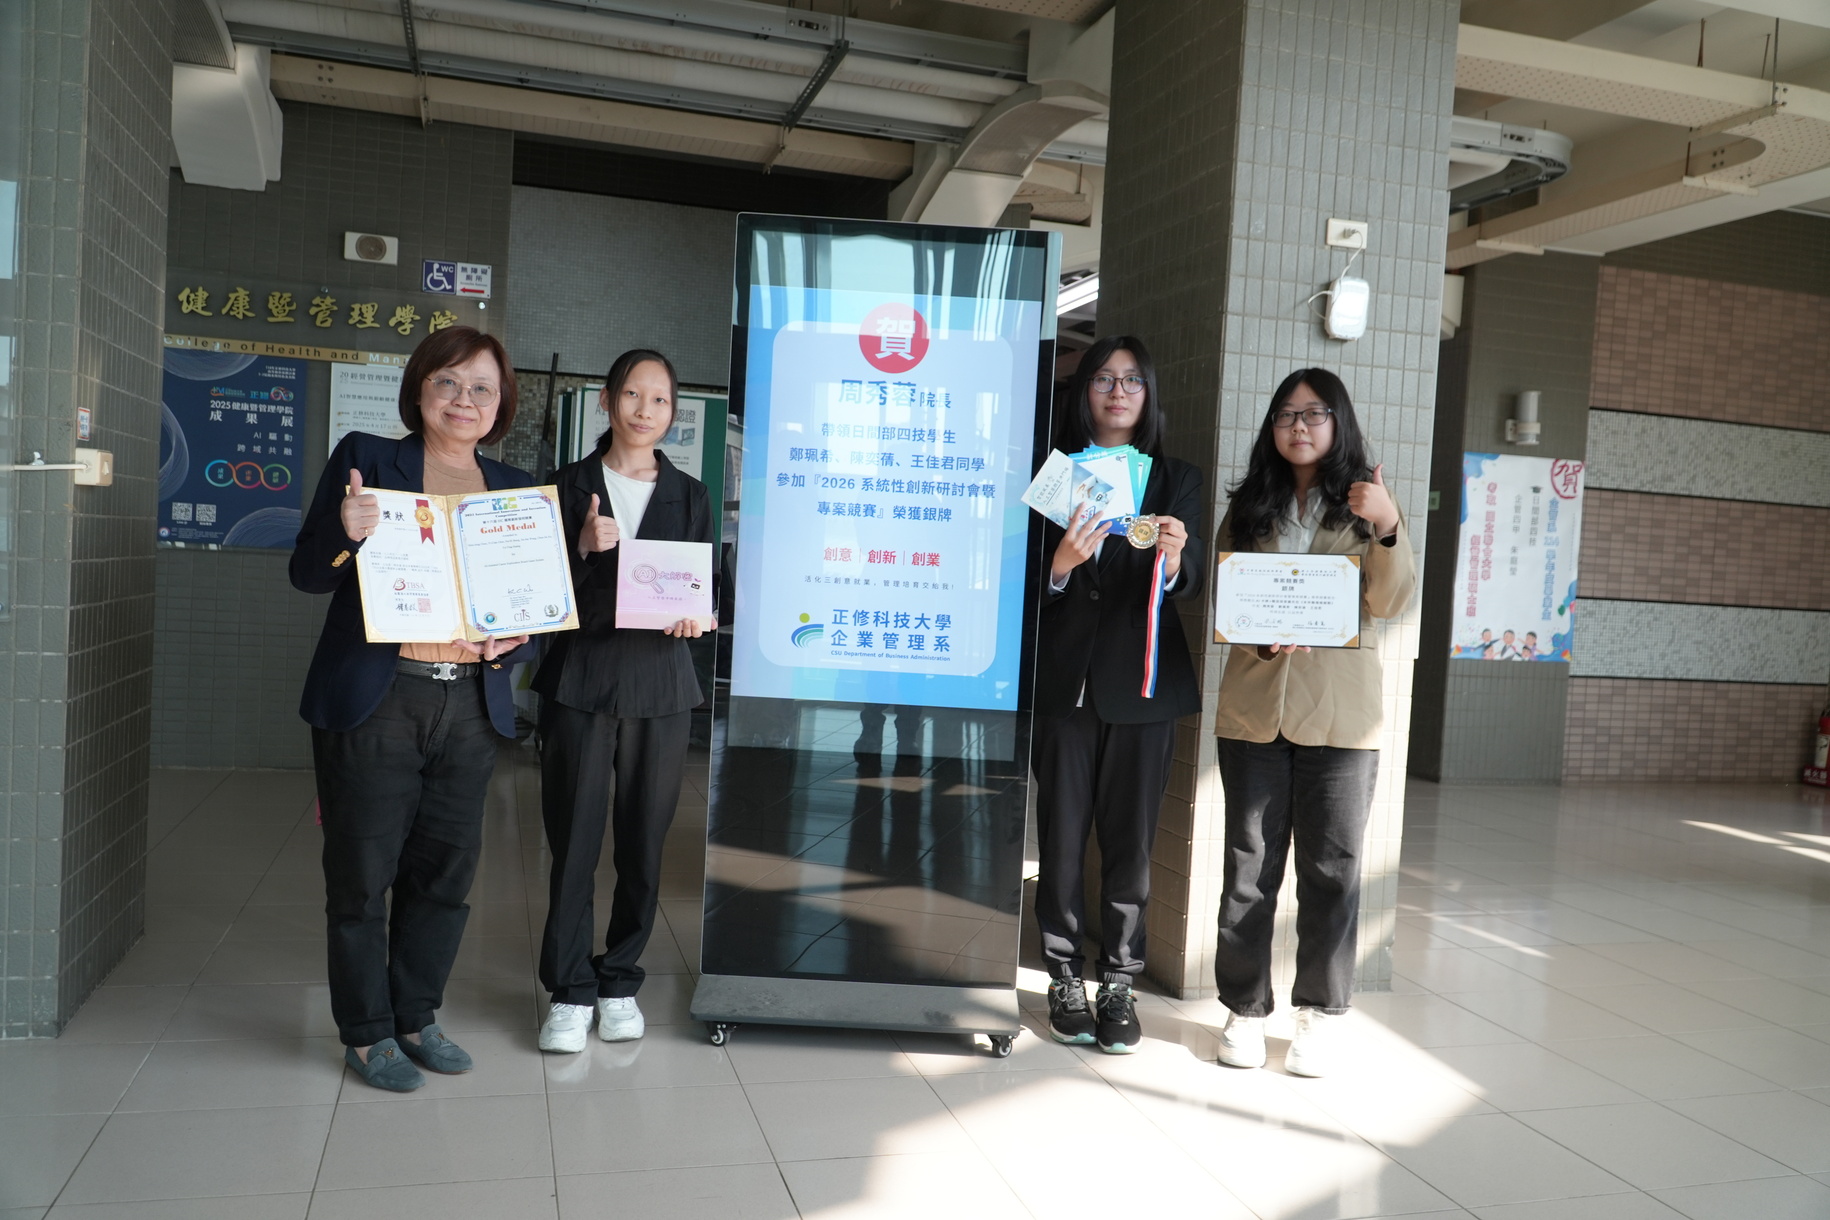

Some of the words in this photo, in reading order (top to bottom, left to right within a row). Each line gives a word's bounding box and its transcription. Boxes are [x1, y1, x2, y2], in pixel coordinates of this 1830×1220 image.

[440, 265, 454, 273] WC
[875, 317, 916, 361] 賀
[240, 342, 256, 351] of
[265, 343, 321, 357] Health
[330, 350, 359, 361] and
[209, 410, 294, 428] 成果展
[821, 422, 956, 444] 帶領日間部四技學生
[1554, 462, 1583, 494] 賀
[860, 478, 996, 499] 系統性創新研討會暨
[480, 525, 508, 534] Gold
[511, 521, 541, 532] Medal
[823, 547, 853, 563] 創意
[867, 549, 897, 565] 創新
[911, 552, 941, 567] 創業
[831, 609, 952, 631] 正修科技大學
[830, 629, 950, 653] 企業管理系
[843, 651, 876, 659] Department
[910, 654, 951, 662] Administration
